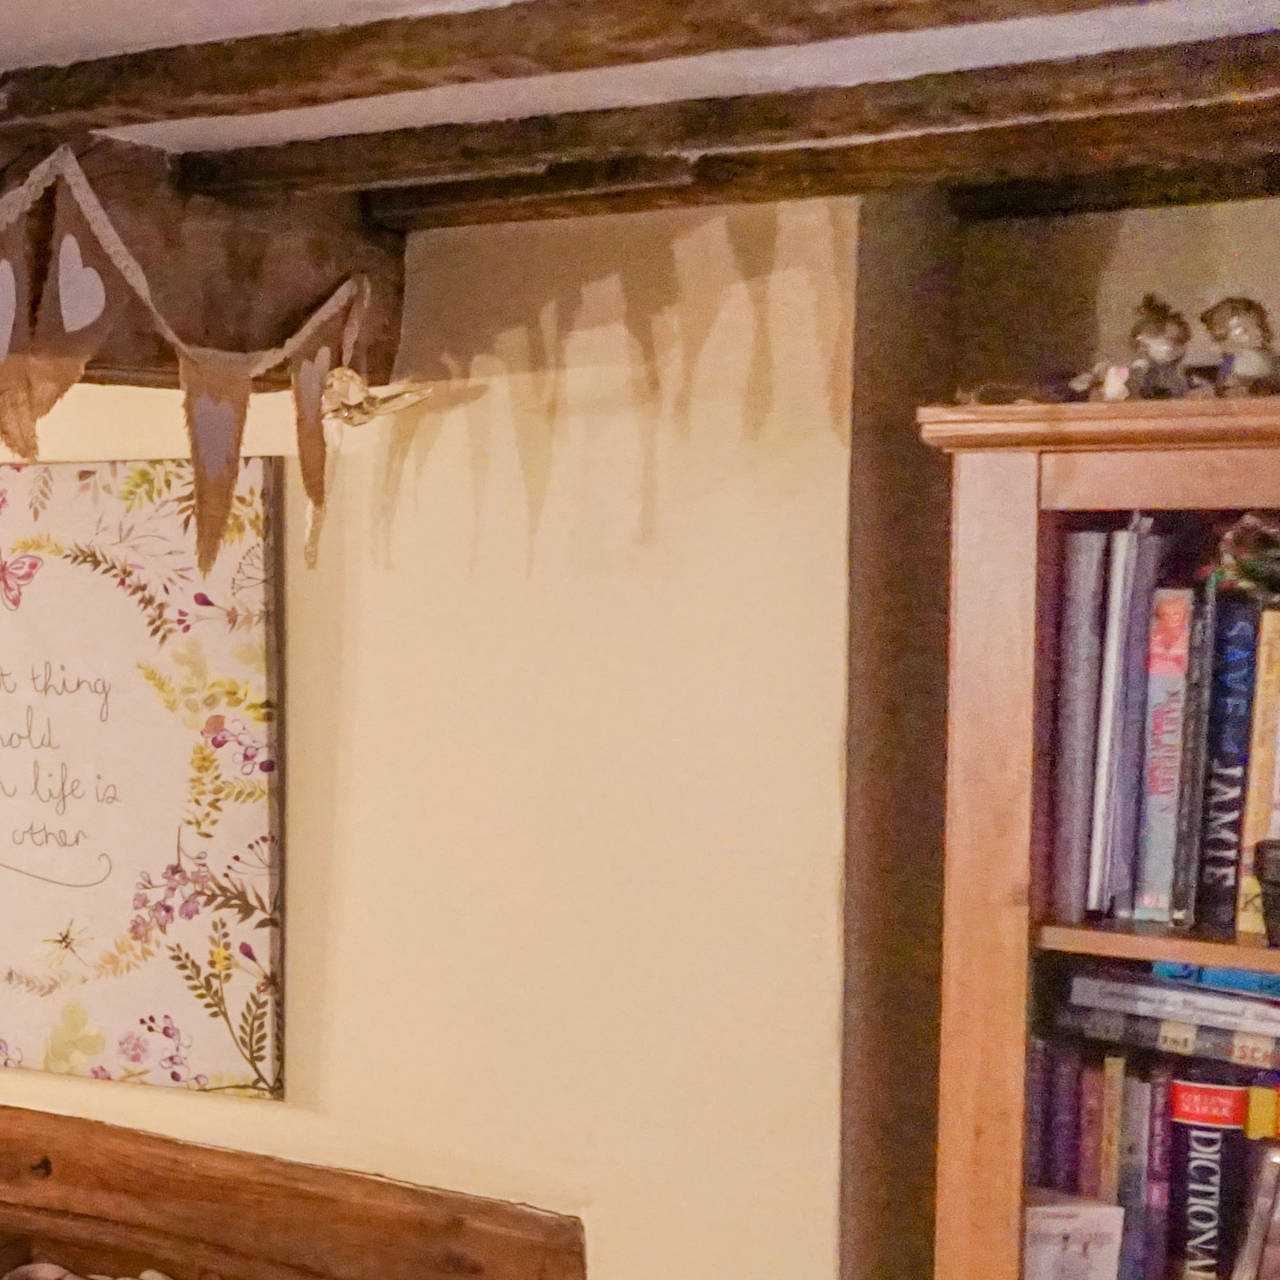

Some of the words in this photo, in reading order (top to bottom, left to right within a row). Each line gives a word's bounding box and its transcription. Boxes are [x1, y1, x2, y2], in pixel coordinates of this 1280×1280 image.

[30, 660, 112, 722] thing
[31, 760, 86, 815] life
[95, 774, 119, 803] is
[11, 822, 88, 848] other
[1204, 759, 1243, 887] JAMIE
